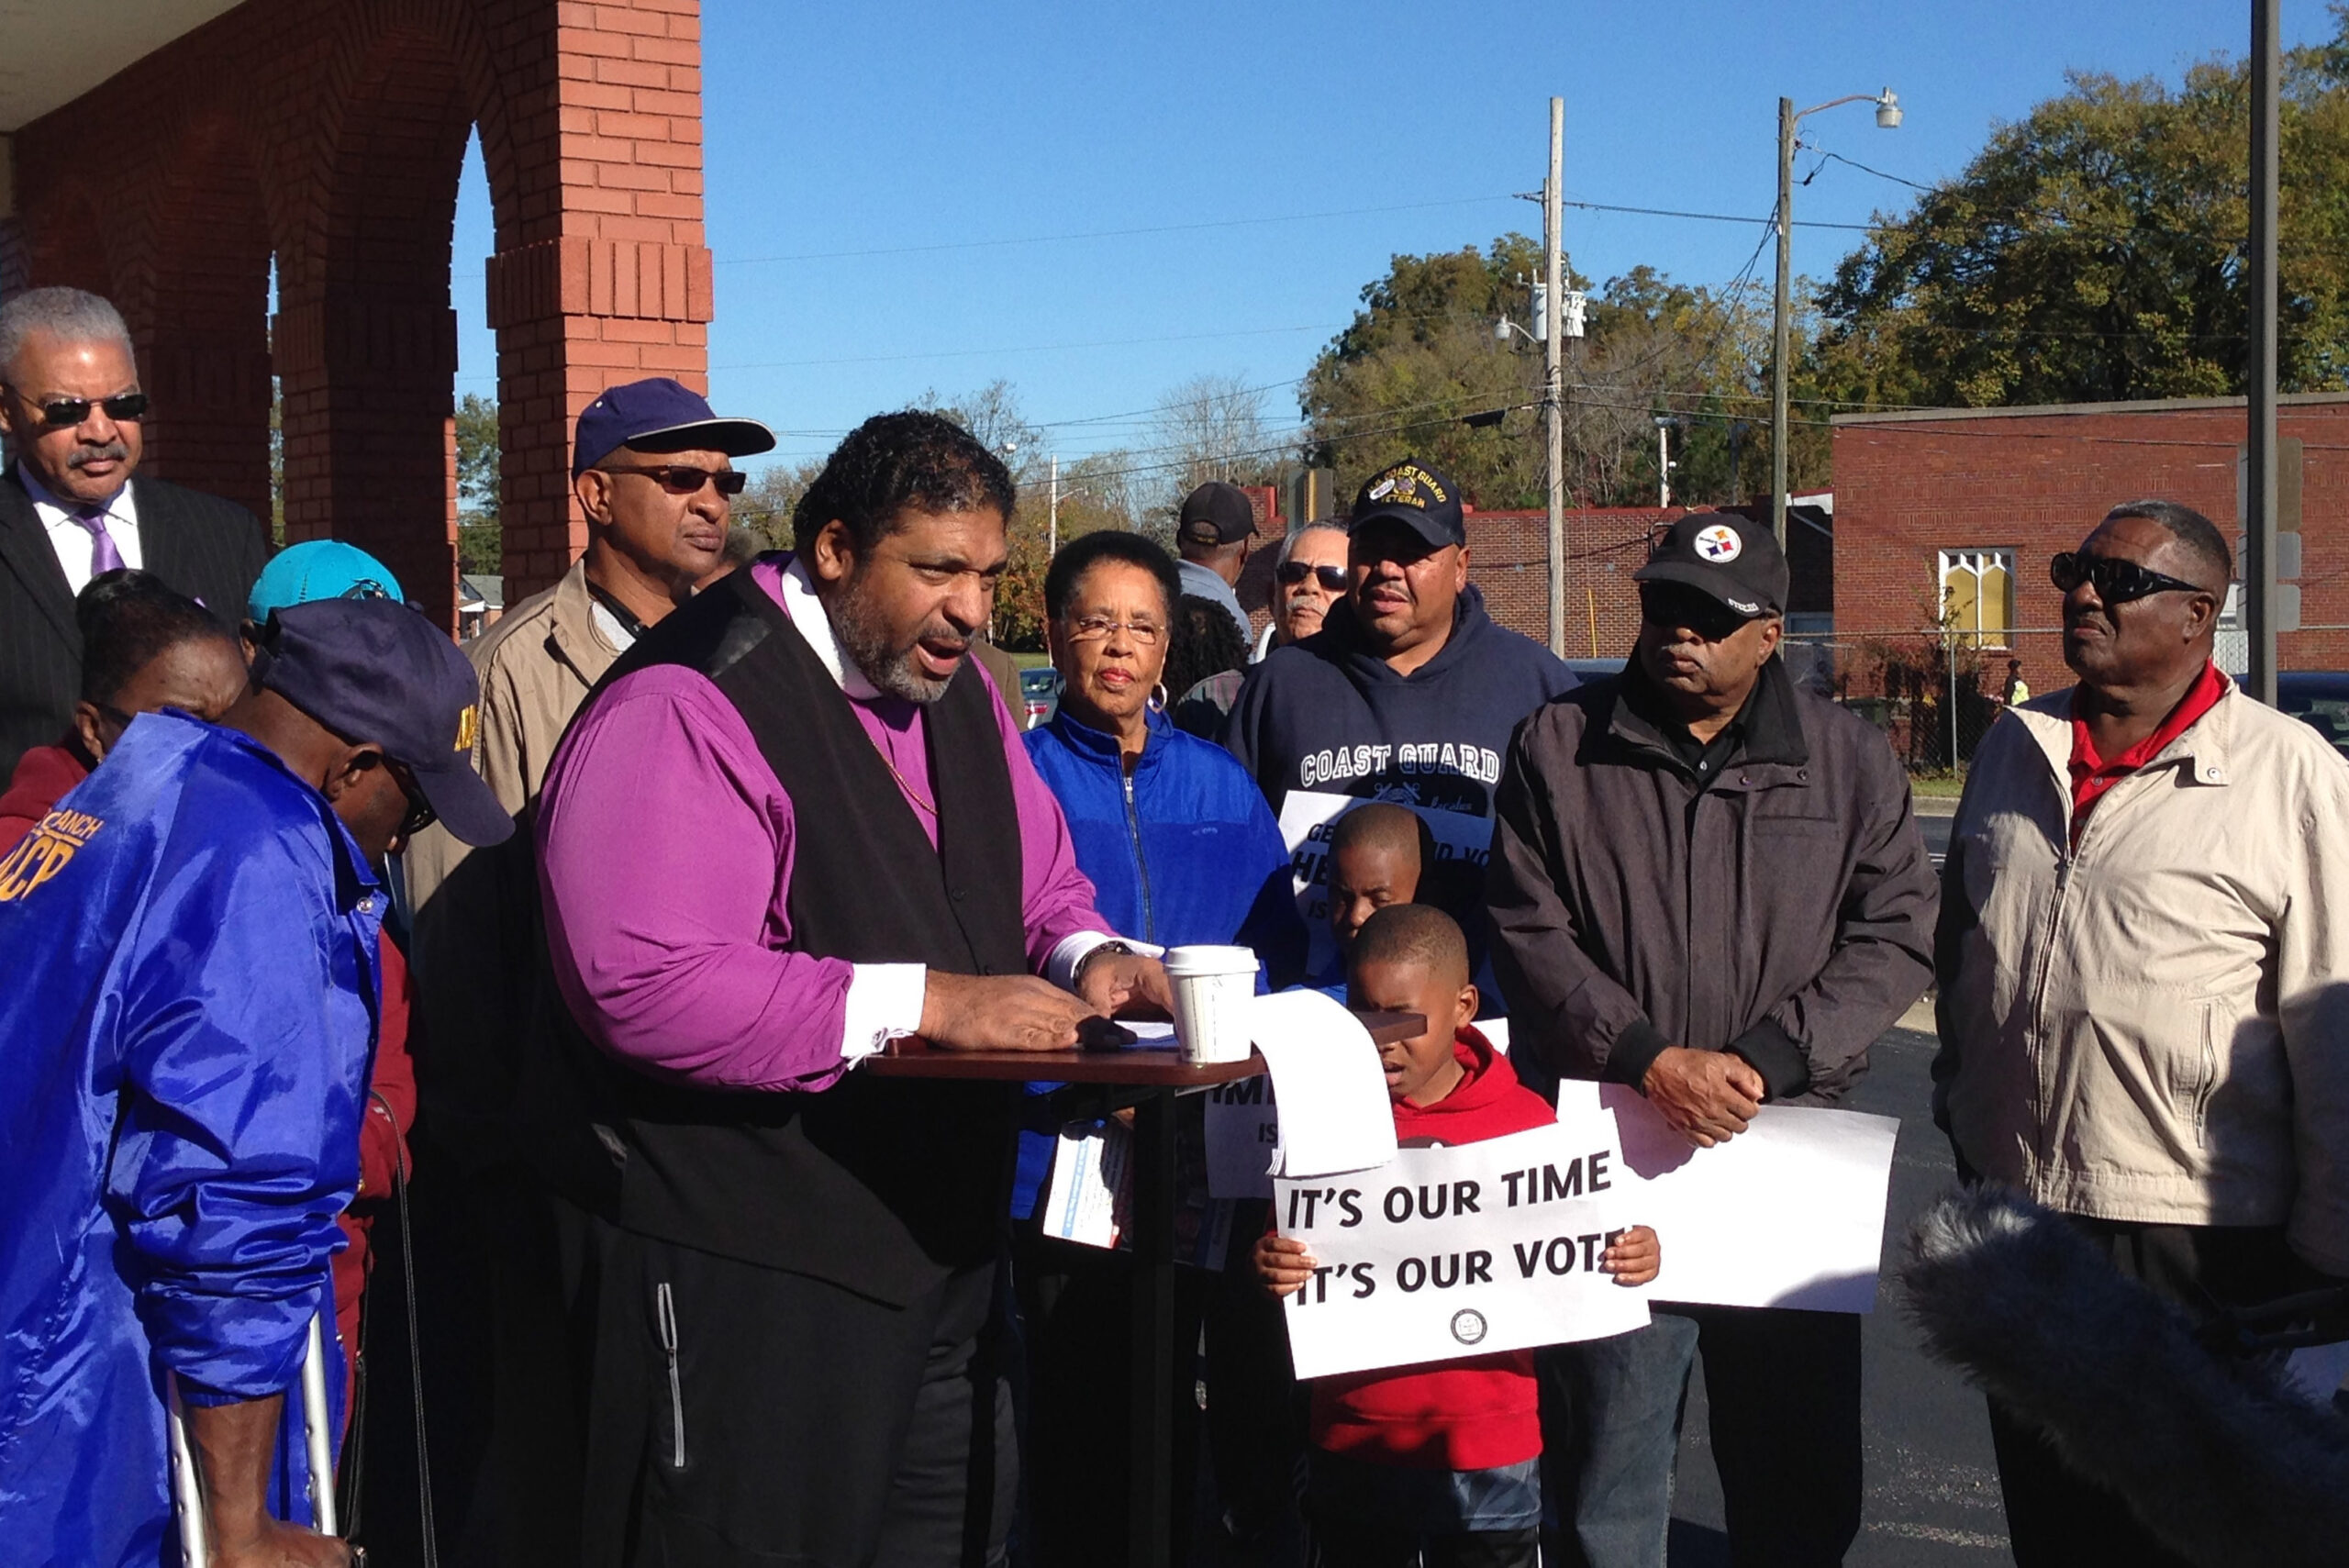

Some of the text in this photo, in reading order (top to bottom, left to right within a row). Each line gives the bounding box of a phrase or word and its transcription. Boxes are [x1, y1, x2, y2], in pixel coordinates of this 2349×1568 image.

[1418, 470, 1447, 504] GUARD
[1300, 742, 1500, 788] COAST GUARD
[1288, 1150, 1612, 1229] IT'S OUR TIME
[1297, 1262, 1376, 1307] IT'S
[1396, 1250, 1493, 1293] OUR
